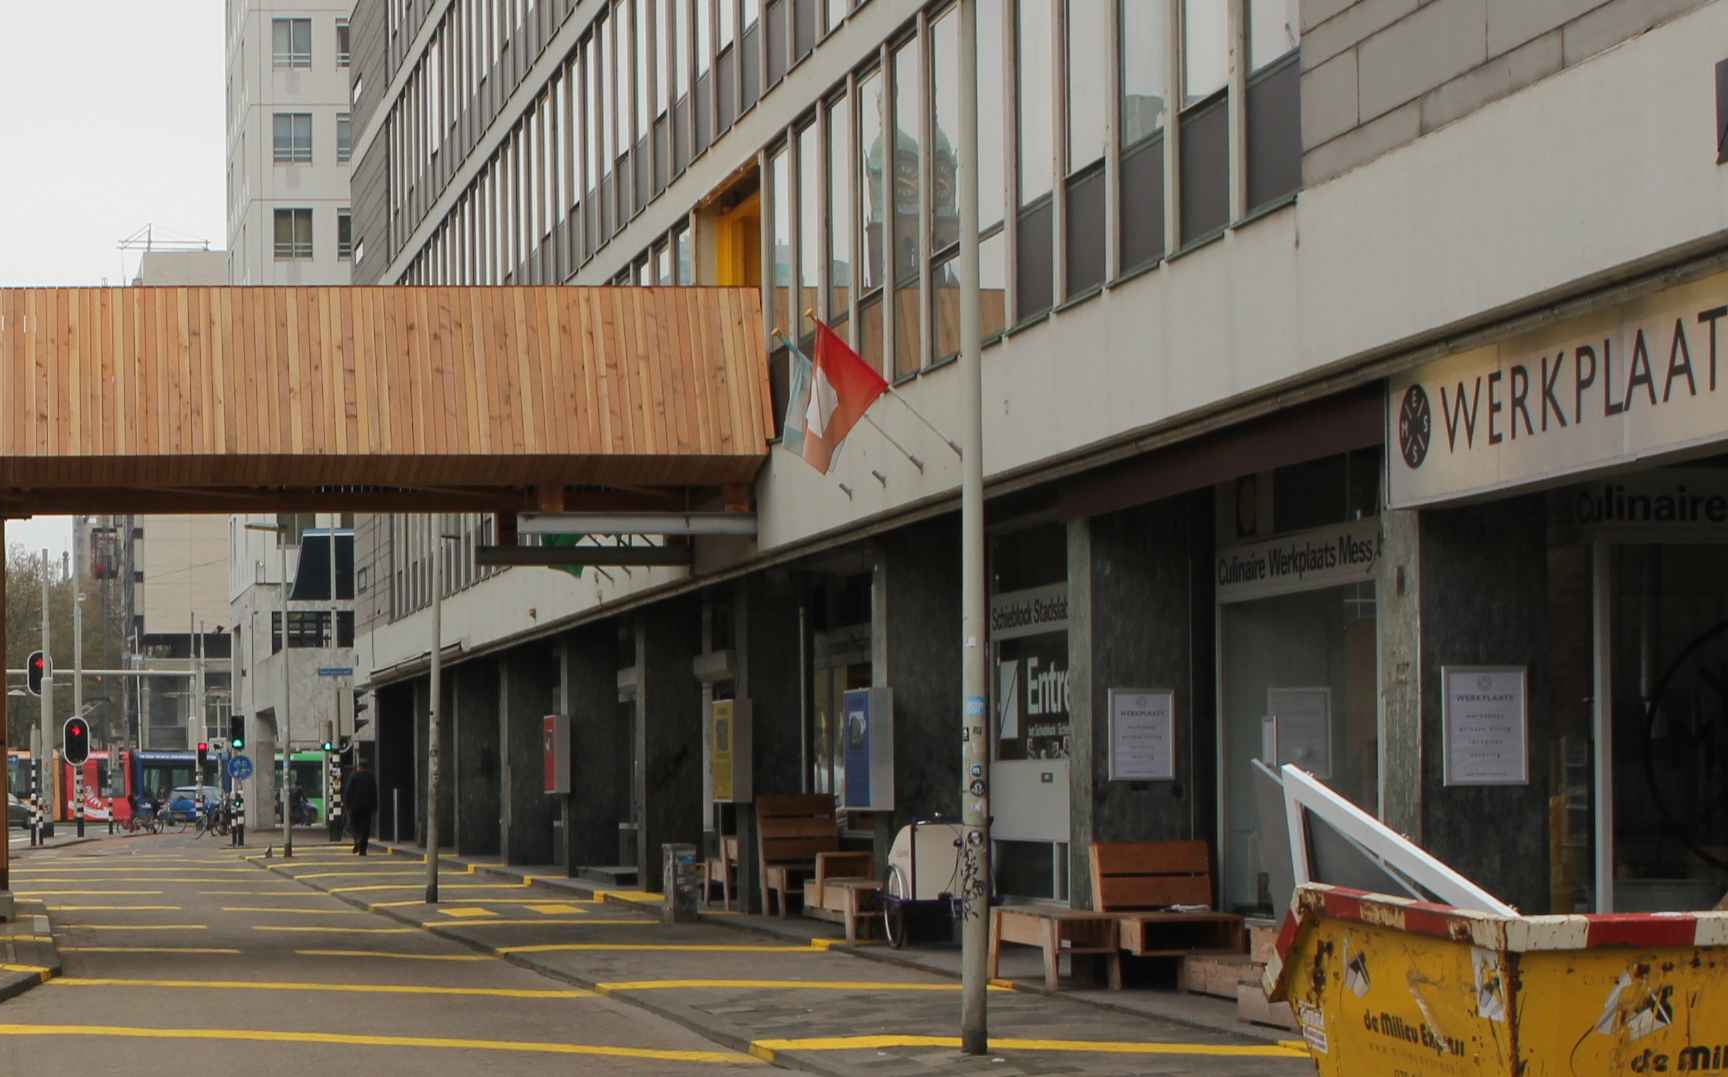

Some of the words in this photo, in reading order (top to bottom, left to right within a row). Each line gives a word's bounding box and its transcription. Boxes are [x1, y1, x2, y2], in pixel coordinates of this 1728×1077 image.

[1440, 305, 1728, 454] WERKPLAAT
[1218, 551, 1266, 586] Culinaire
[1268, 540, 1337, 580] Werkplaats
